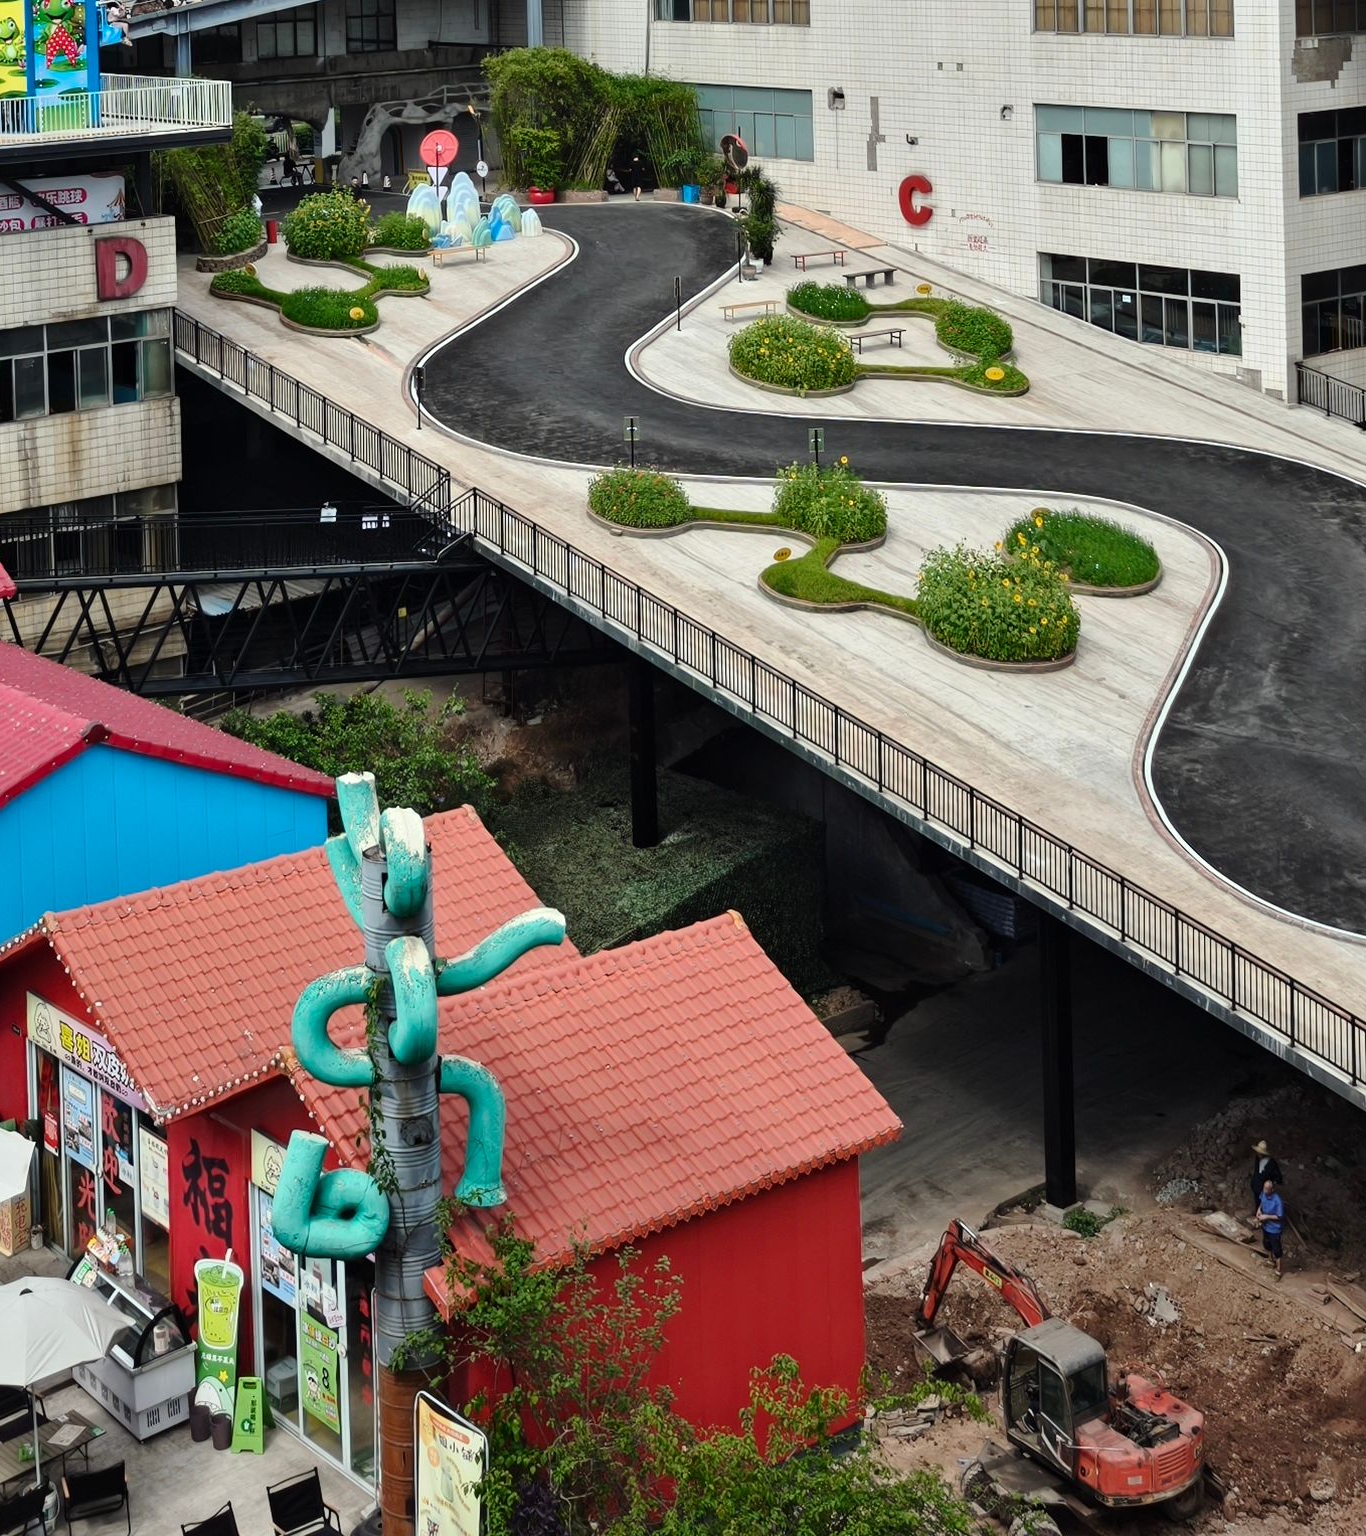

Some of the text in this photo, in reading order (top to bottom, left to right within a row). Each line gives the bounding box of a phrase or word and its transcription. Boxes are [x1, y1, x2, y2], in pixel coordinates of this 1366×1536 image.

[36, 188, 86, 208] 乐跳球
[898, 174, 933, 227] C
[95, 236, 149, 302] D
